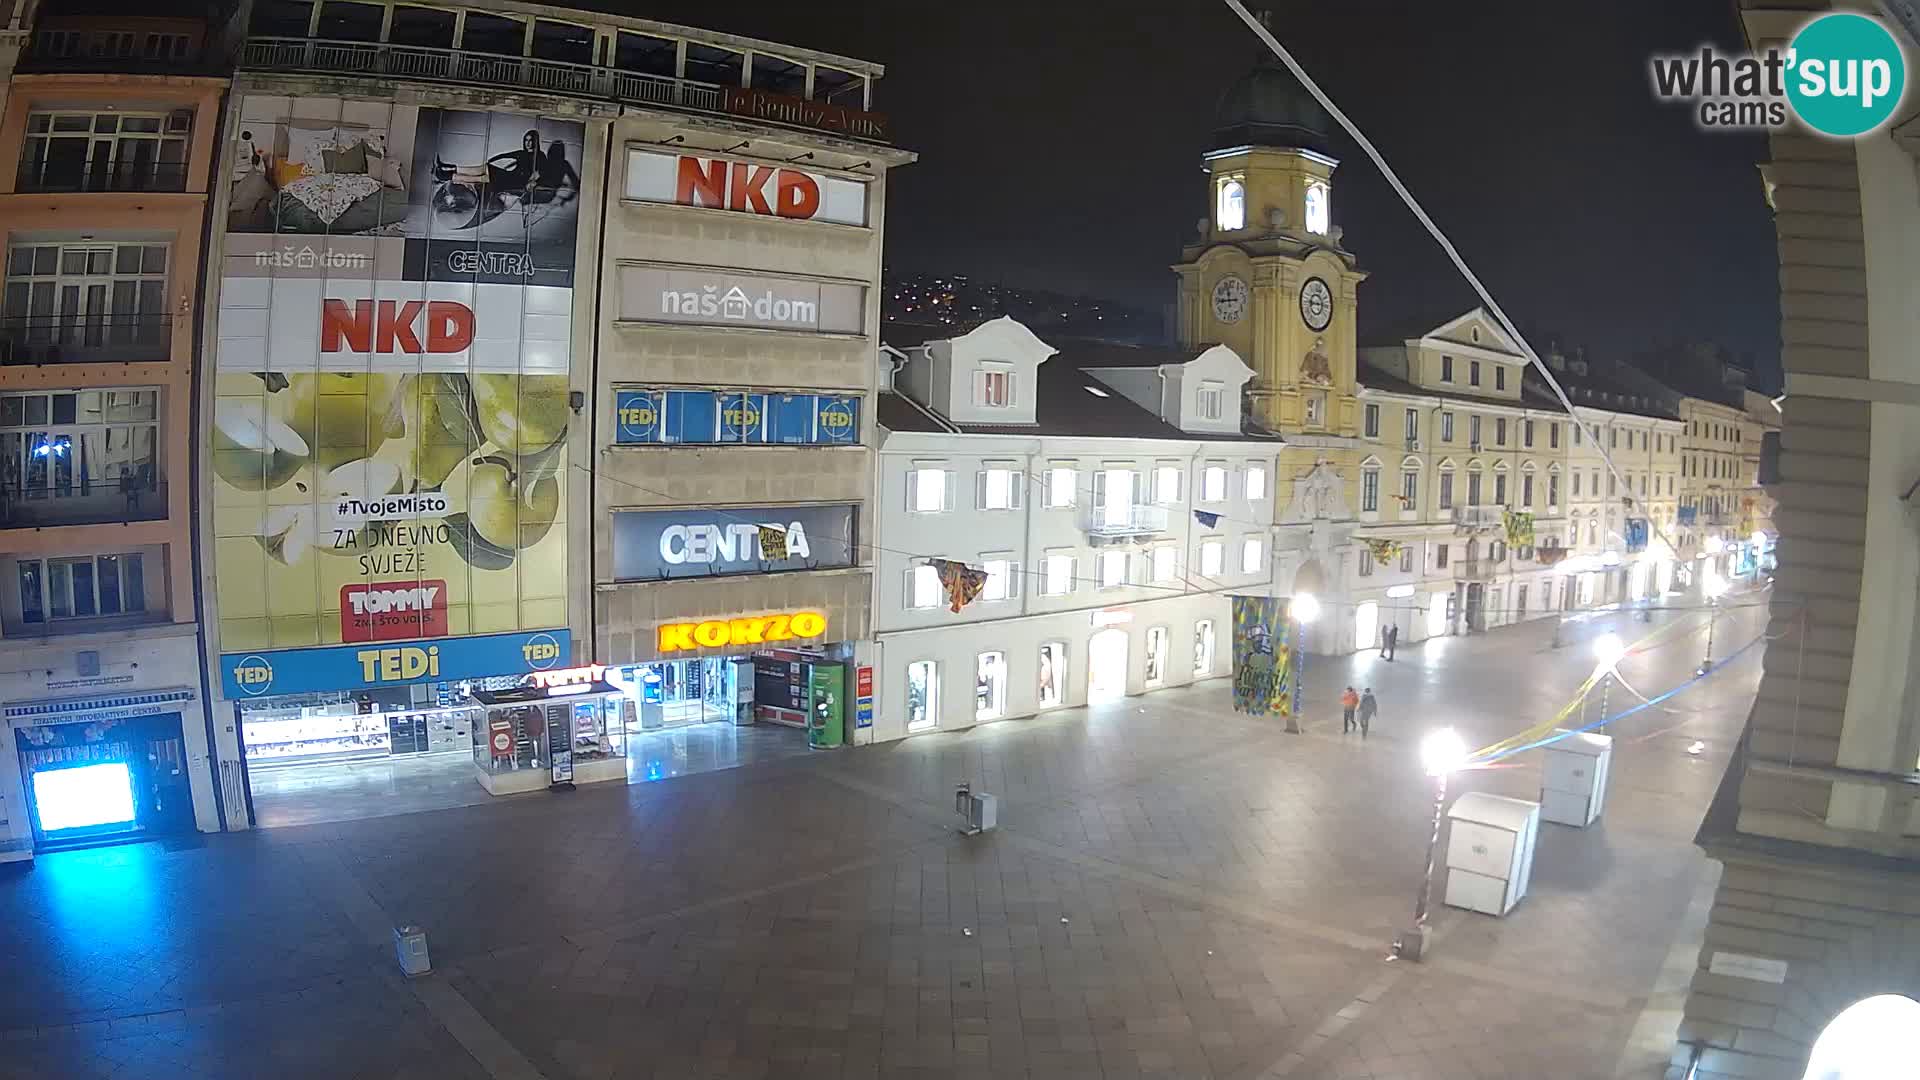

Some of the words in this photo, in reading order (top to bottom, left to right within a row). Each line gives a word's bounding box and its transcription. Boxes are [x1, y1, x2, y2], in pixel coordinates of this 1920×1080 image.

[676, 155, 820, 220] NKD
[255, 246, 295, 267] naš
[319, 248, 366, 269] dom
[448, 249, 535, 276] CENTRA
[662, 284, 718, 317] naš
[754, 287, 816, 322] dom
[321, 297, 477, 353] NKD
[619, 408, 658, 426] TEDi
[723, 408, 760, 426] TEDi
[820, 411, 853, 427] TEDi
[333, 529, 358, 549] ZA
[368, 524, 450, 548] DNEVNO
[359, 547, 427, 576] SVJEŽE
[349, 587, 440, 615] TOMMY
[379, 614, 400, 626] ŠTO
[657, 612, 827, 652] KORZO
[357, 645, 439, 682] TEDi
[522, 643, 560, 661] TEDi
[233, 666, 273, 684] TEDi
